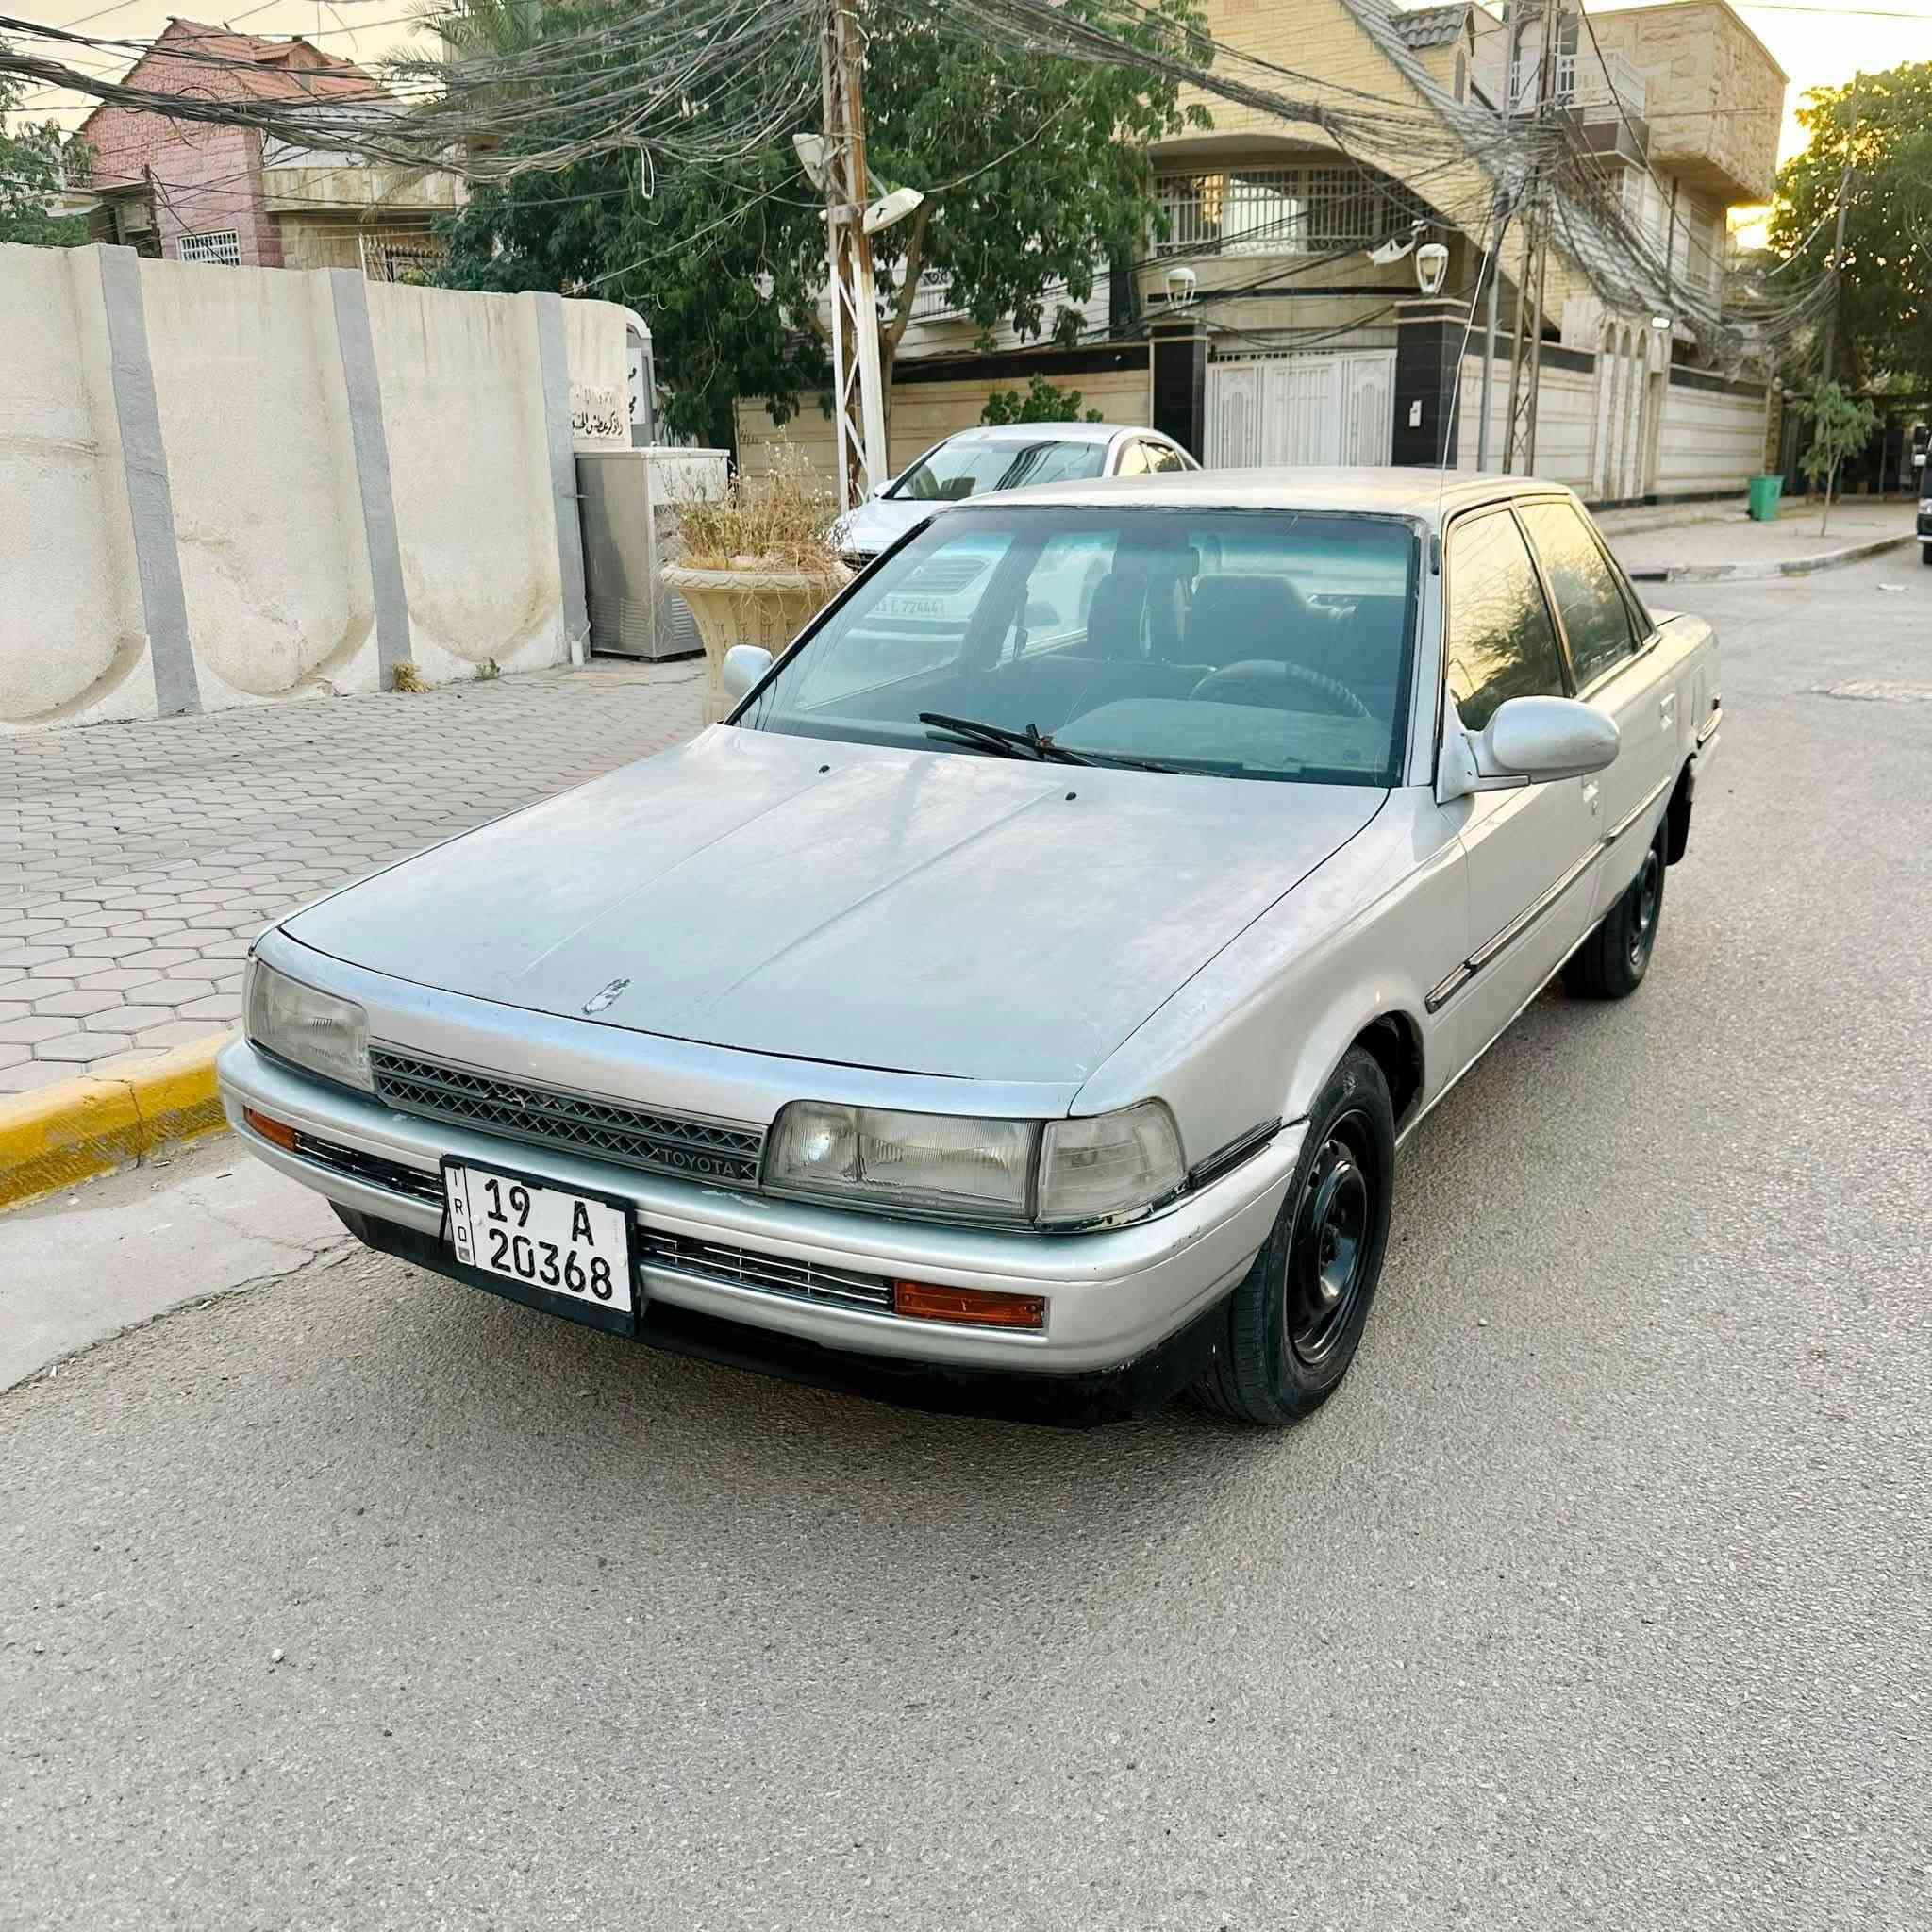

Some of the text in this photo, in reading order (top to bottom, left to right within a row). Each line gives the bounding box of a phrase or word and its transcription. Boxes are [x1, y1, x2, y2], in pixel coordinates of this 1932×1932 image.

[662, 1148, 736, 1176] TOYOTA
[453, 1170, 468, 1242] IRQ
[485, 1178, 530, 1227] 19
[572, 1200, 594, 1246] A
[489, 1228, 613, 1300] 20368
